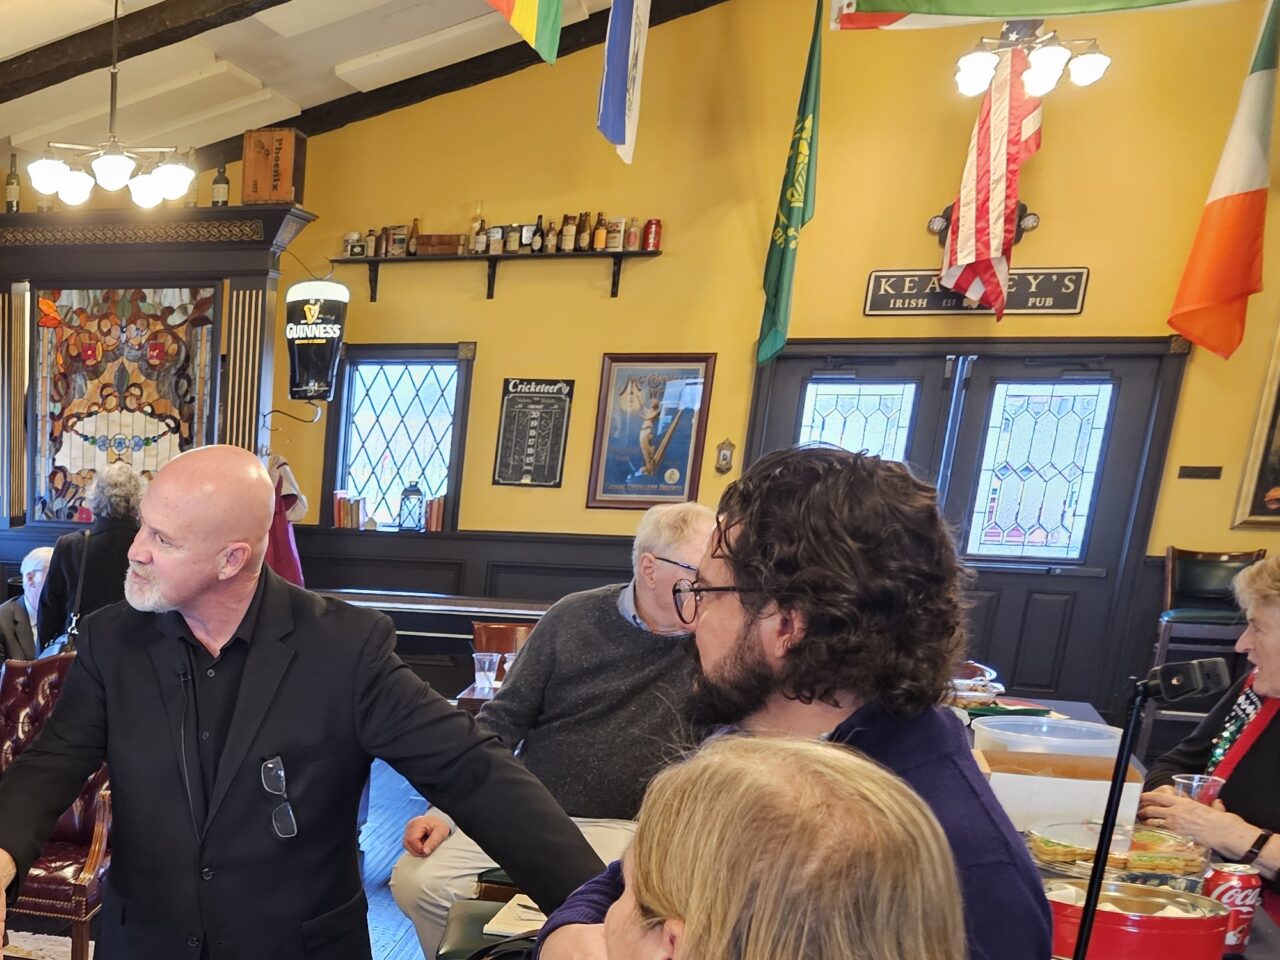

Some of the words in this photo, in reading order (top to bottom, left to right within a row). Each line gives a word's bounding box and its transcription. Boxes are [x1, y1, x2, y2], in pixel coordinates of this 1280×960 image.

[272, 137, 283, 193] Phoenix
[878, 275, 1076, 294] KEAEY'S
[889, 299, 928, 308] IRISH
[1028, 297, 1053, 307] PUB
[286, 323, 341, 339] GUINNESS
[508, 380, 560, 393] Cricketeer
